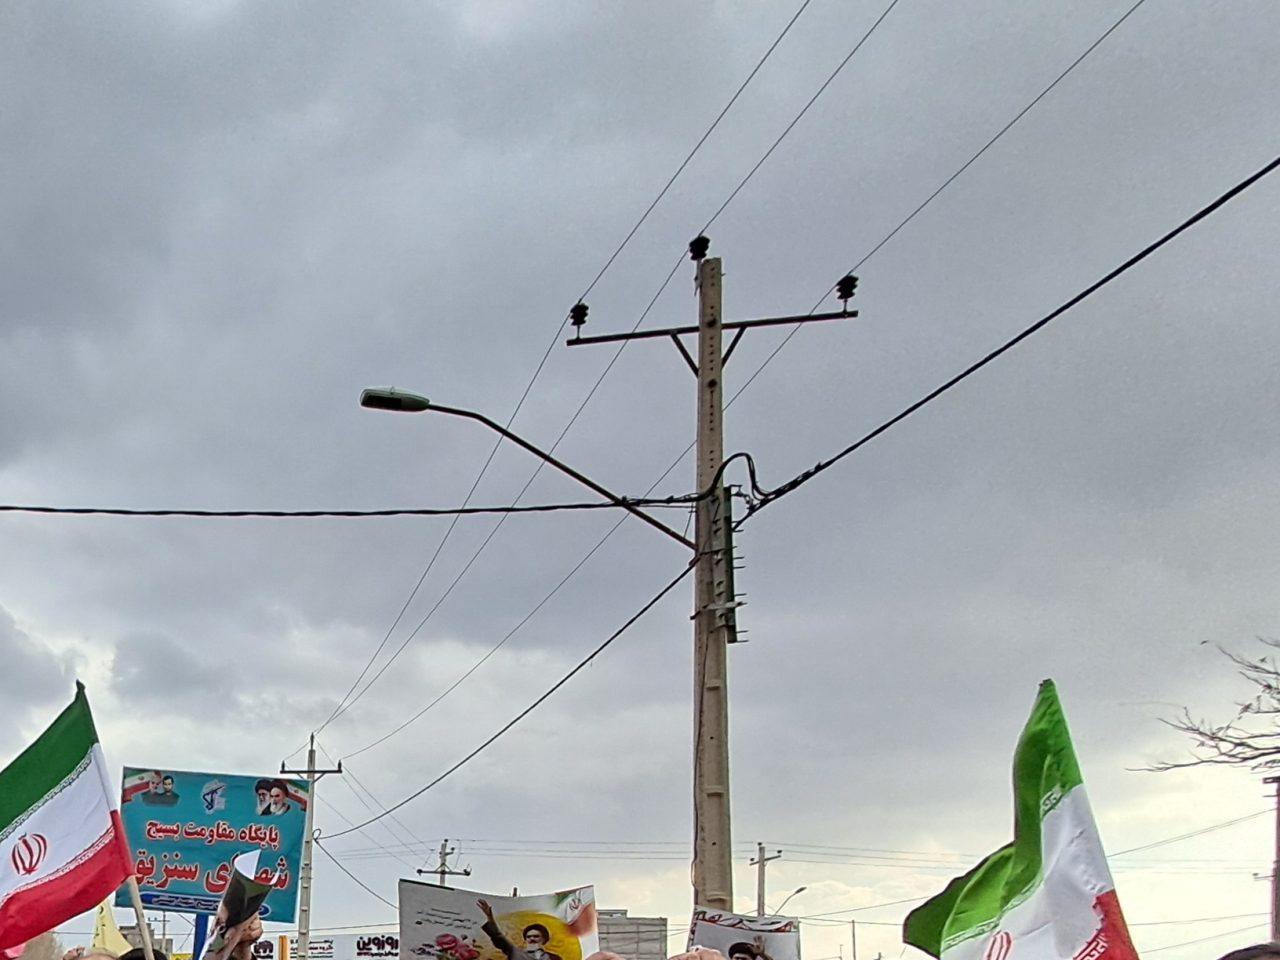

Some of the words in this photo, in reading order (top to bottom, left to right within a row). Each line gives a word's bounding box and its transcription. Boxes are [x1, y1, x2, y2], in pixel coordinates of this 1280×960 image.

[146, 820, 180, 841] بسیج
[183, 820, 236, 844] مقاومت
[239, 823, 280, 849] پایگاه
